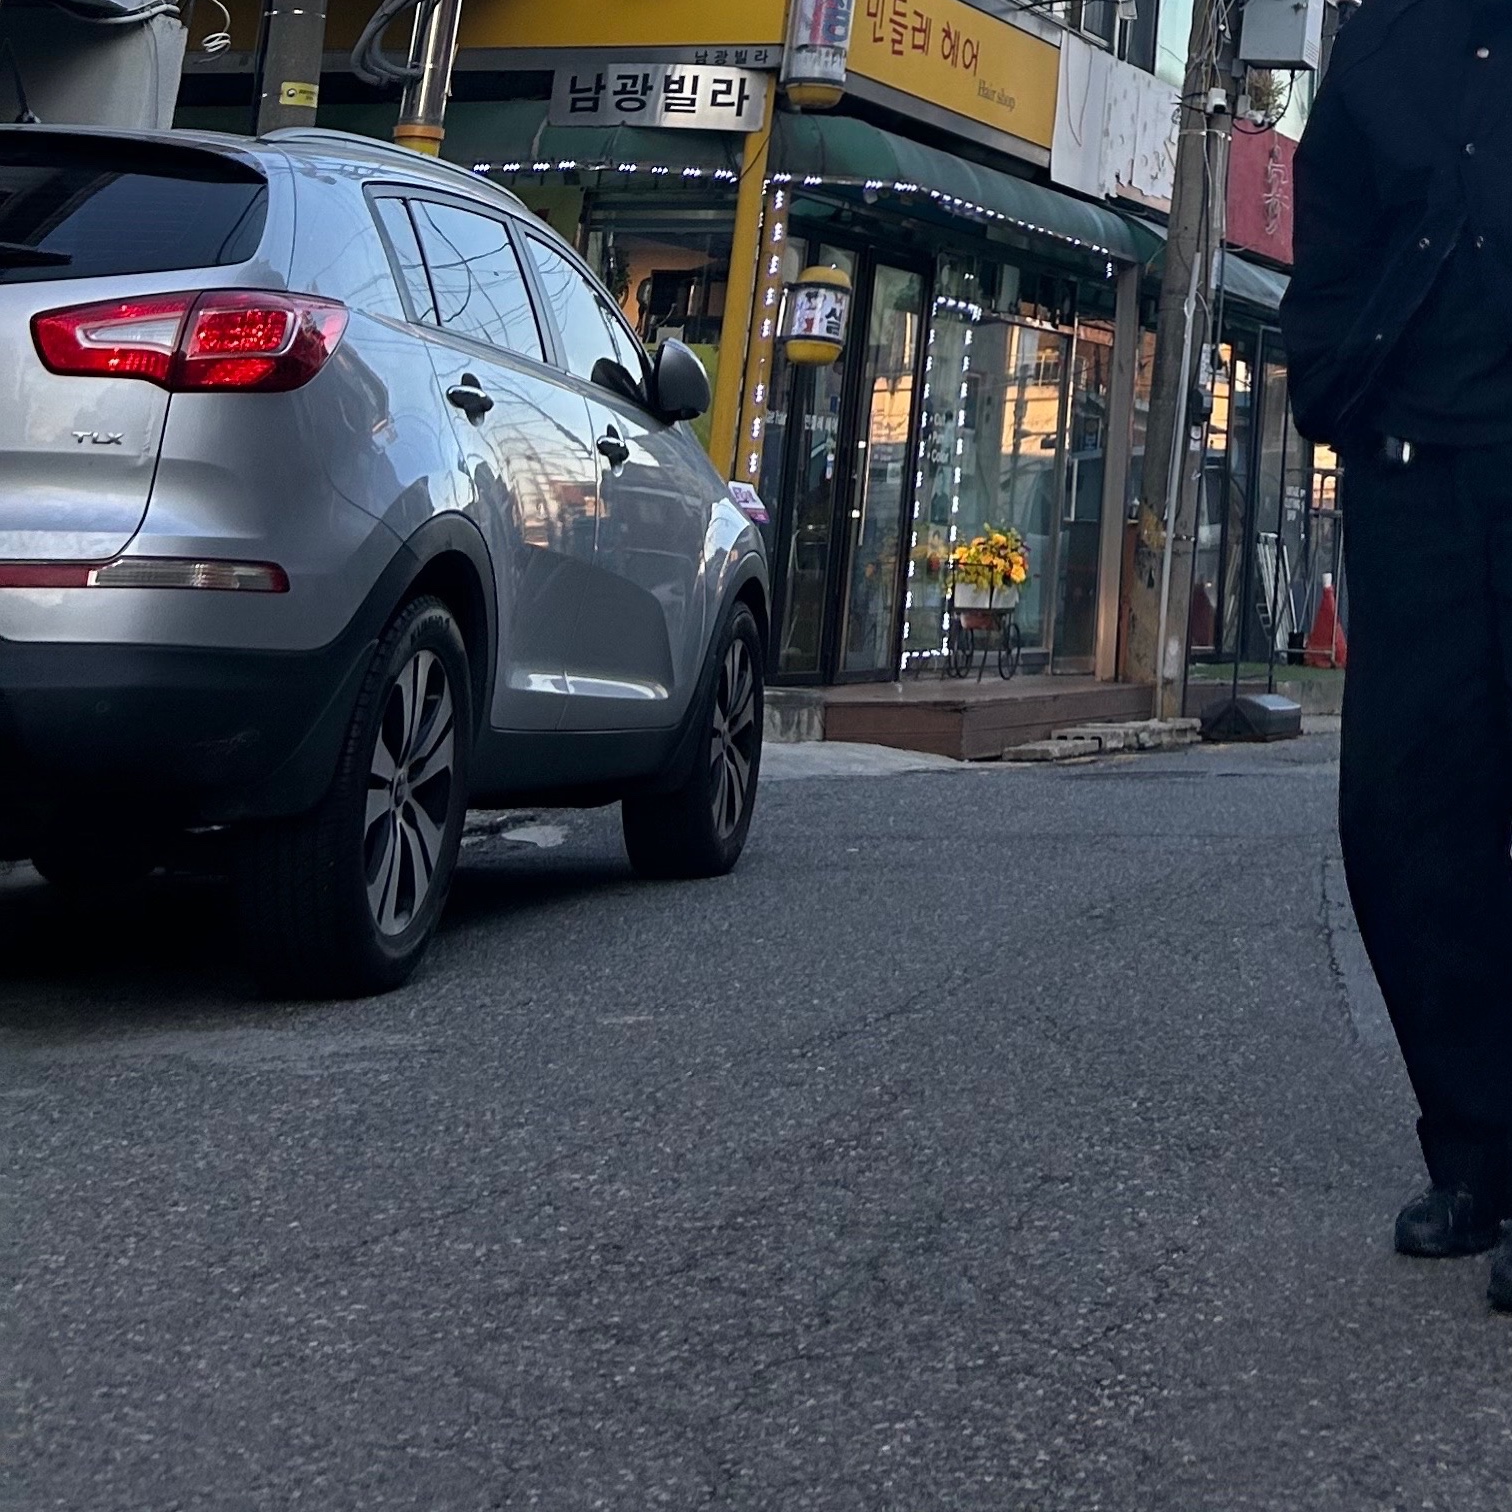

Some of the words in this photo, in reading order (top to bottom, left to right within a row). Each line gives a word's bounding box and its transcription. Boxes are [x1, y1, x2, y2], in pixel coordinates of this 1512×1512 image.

[694, 49, 769, 65] 남광빌라
[941, 21, 980, 76] 헤어
[569, 72, 750, 117] 남광빌라
[977, 78, 997, 102] Hair
[996, 87, 1016, 112] shop
[71, 431, 124, 445] TLX
